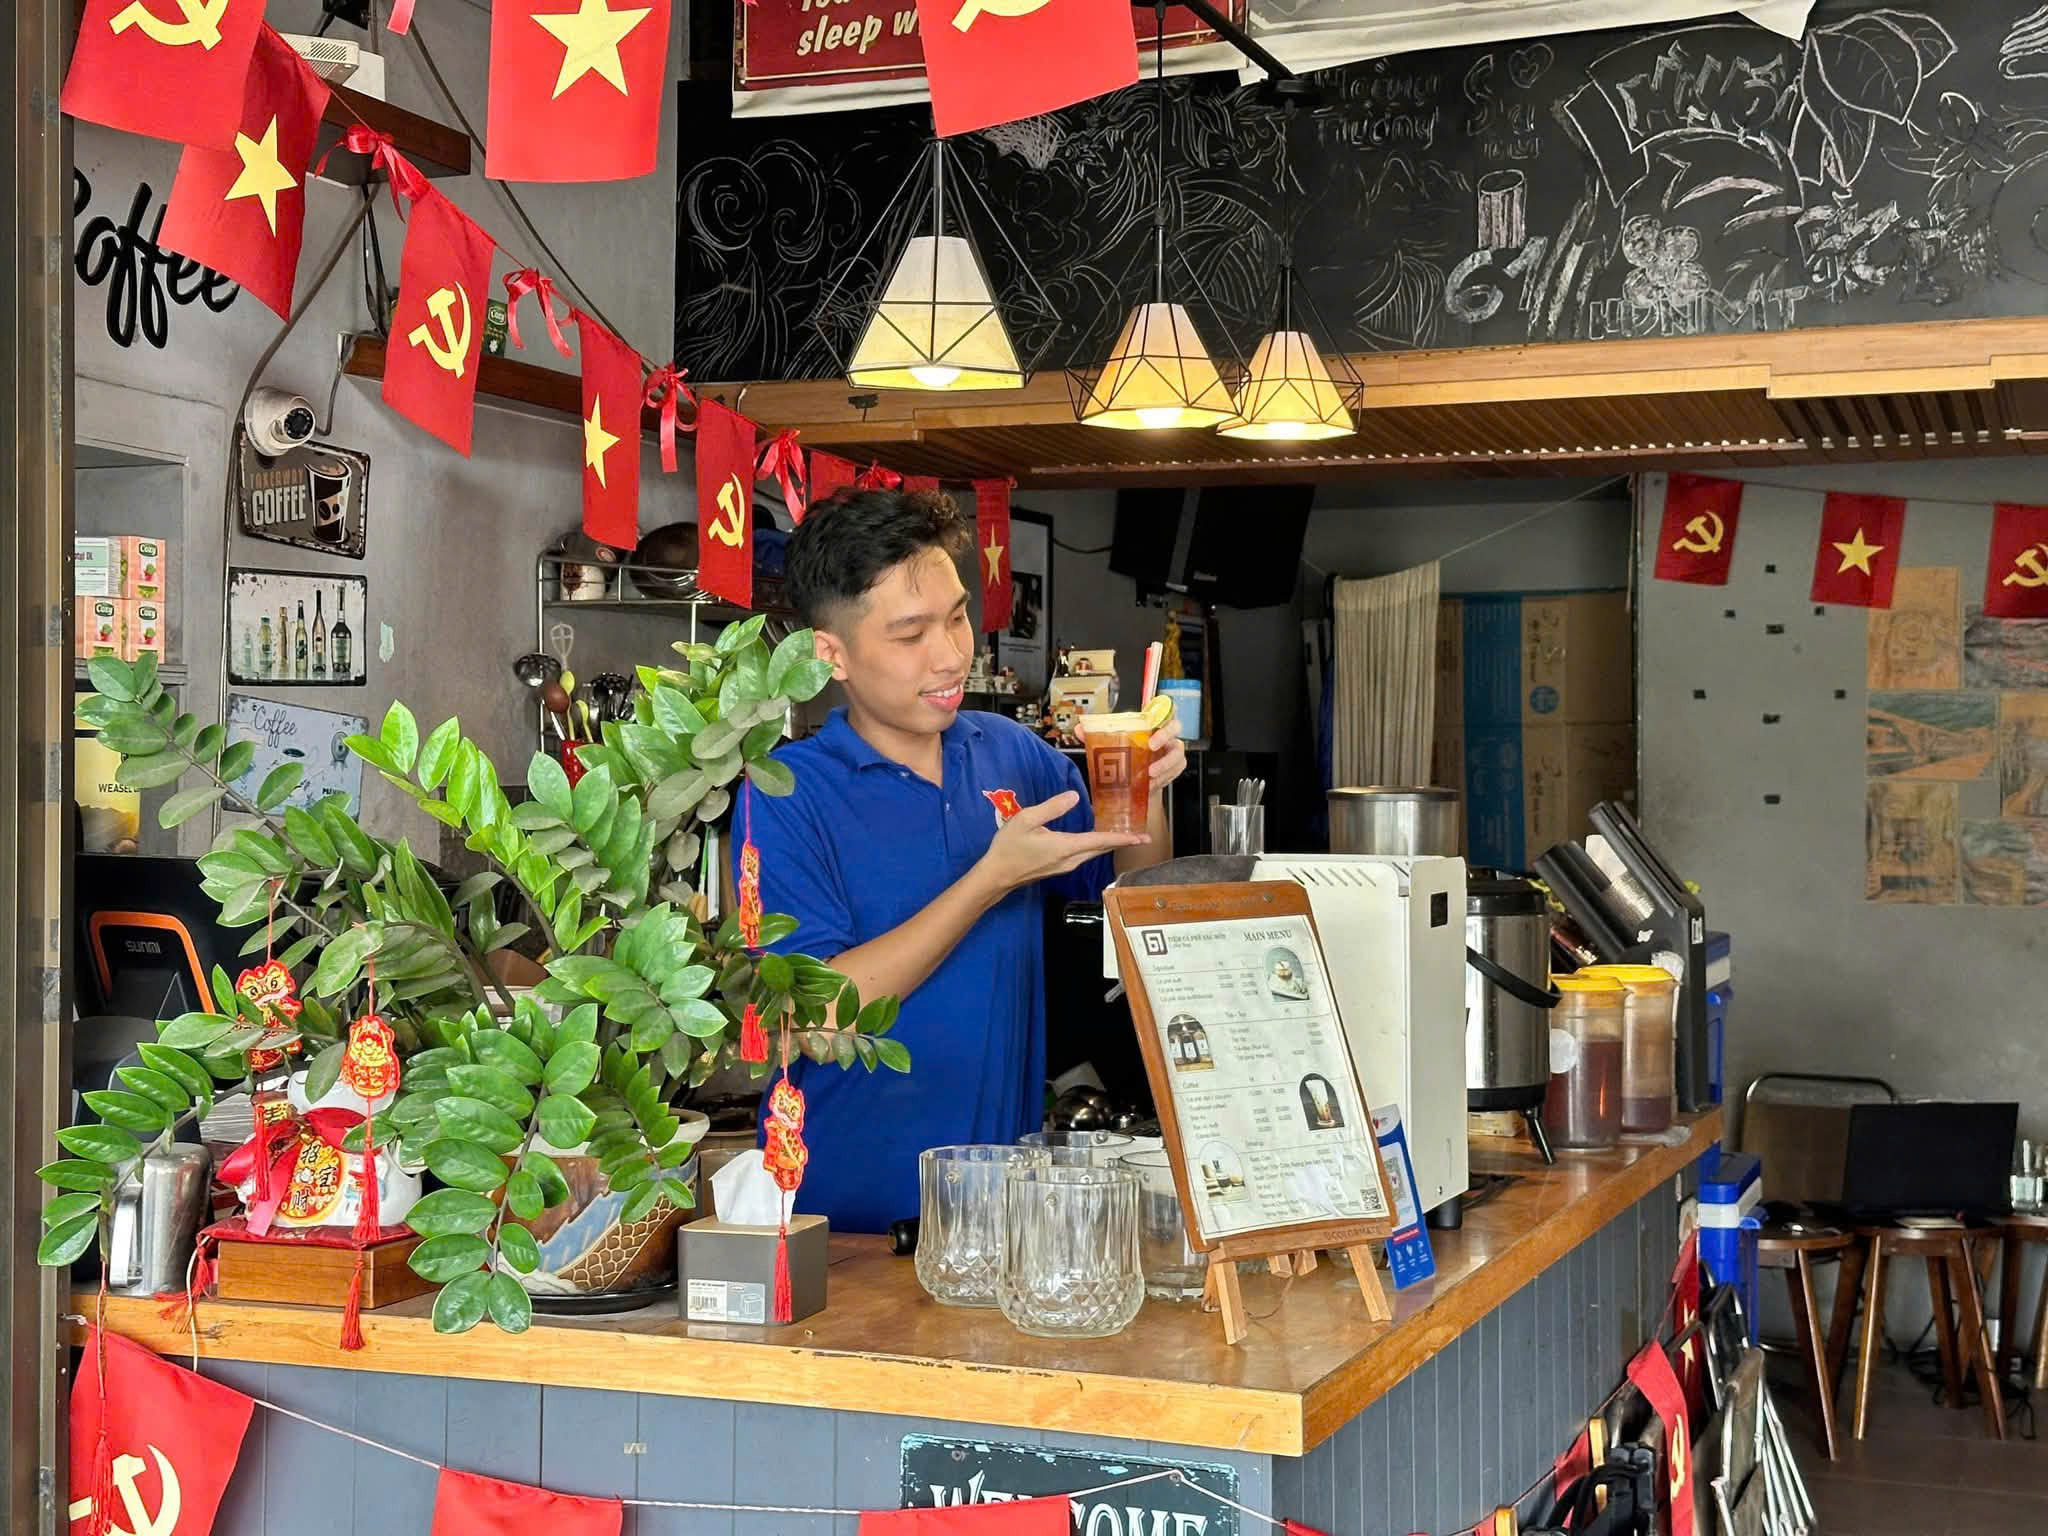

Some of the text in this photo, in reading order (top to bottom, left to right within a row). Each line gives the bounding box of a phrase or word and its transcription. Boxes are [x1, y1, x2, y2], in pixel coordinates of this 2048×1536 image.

[797, 14, 882, 56] sleep
[252, 485, 306, 526] COFFEE
[139, 544, 157, 556] Cozy
[96, 604, 113, 616] Cozy
[139, 607, 157, 619] Cozy
[254, 705, 297, 749] Coffee
[1243, 929, 1293, 941] MAIN MENU
